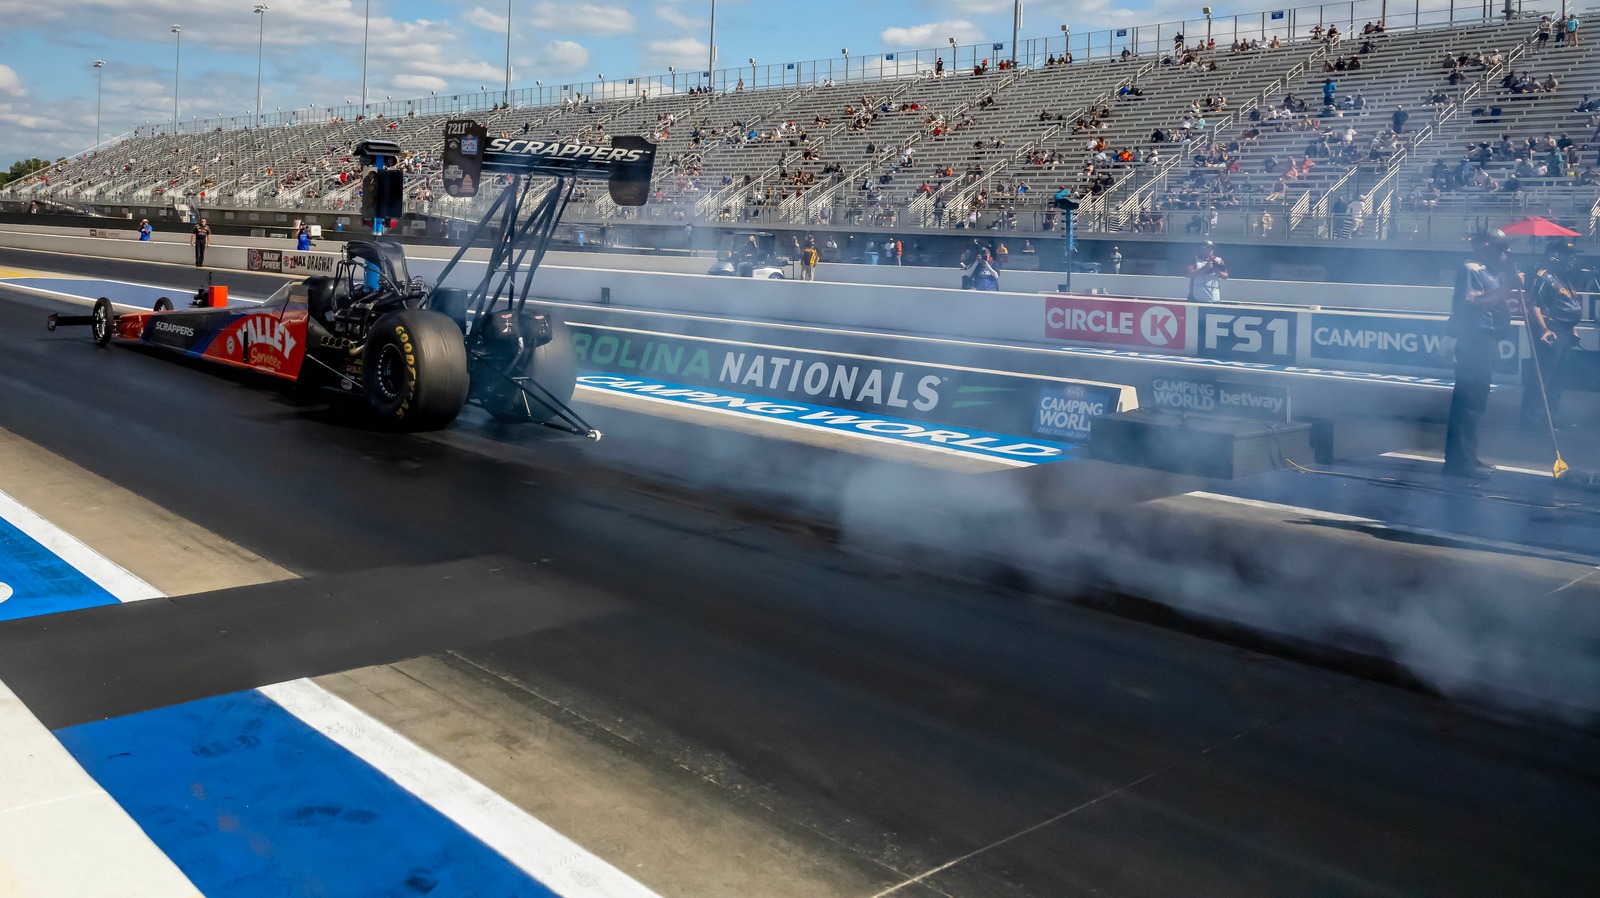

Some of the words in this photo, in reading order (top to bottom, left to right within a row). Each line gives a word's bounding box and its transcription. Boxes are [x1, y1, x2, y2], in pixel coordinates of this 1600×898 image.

[486, 138, 641, 162] SCRAPPERS
[307, 255, 335, 272] DRAGWAY
[155, 321, 194, 337] SCRAPPERS
[1046, 307, 1134, 335] CIRCLE
[1150, 314, 1176, 346] K
[1205, 313, 1289, 355] FS1
[1314, 327, 1418, 353] CAMPING
[572, 331, 711, 380] ROLINA
[1152, 378, 1215, 397] CAMPING
[1041, 396, 1104, 416] CAMPING
[1152, 390, 1216, 411] WORLD
[1220, 389, 1284, 413] betway
[577, 375, 809, 415] CAMPING
[798, 411, 1063, 457] WORLD
